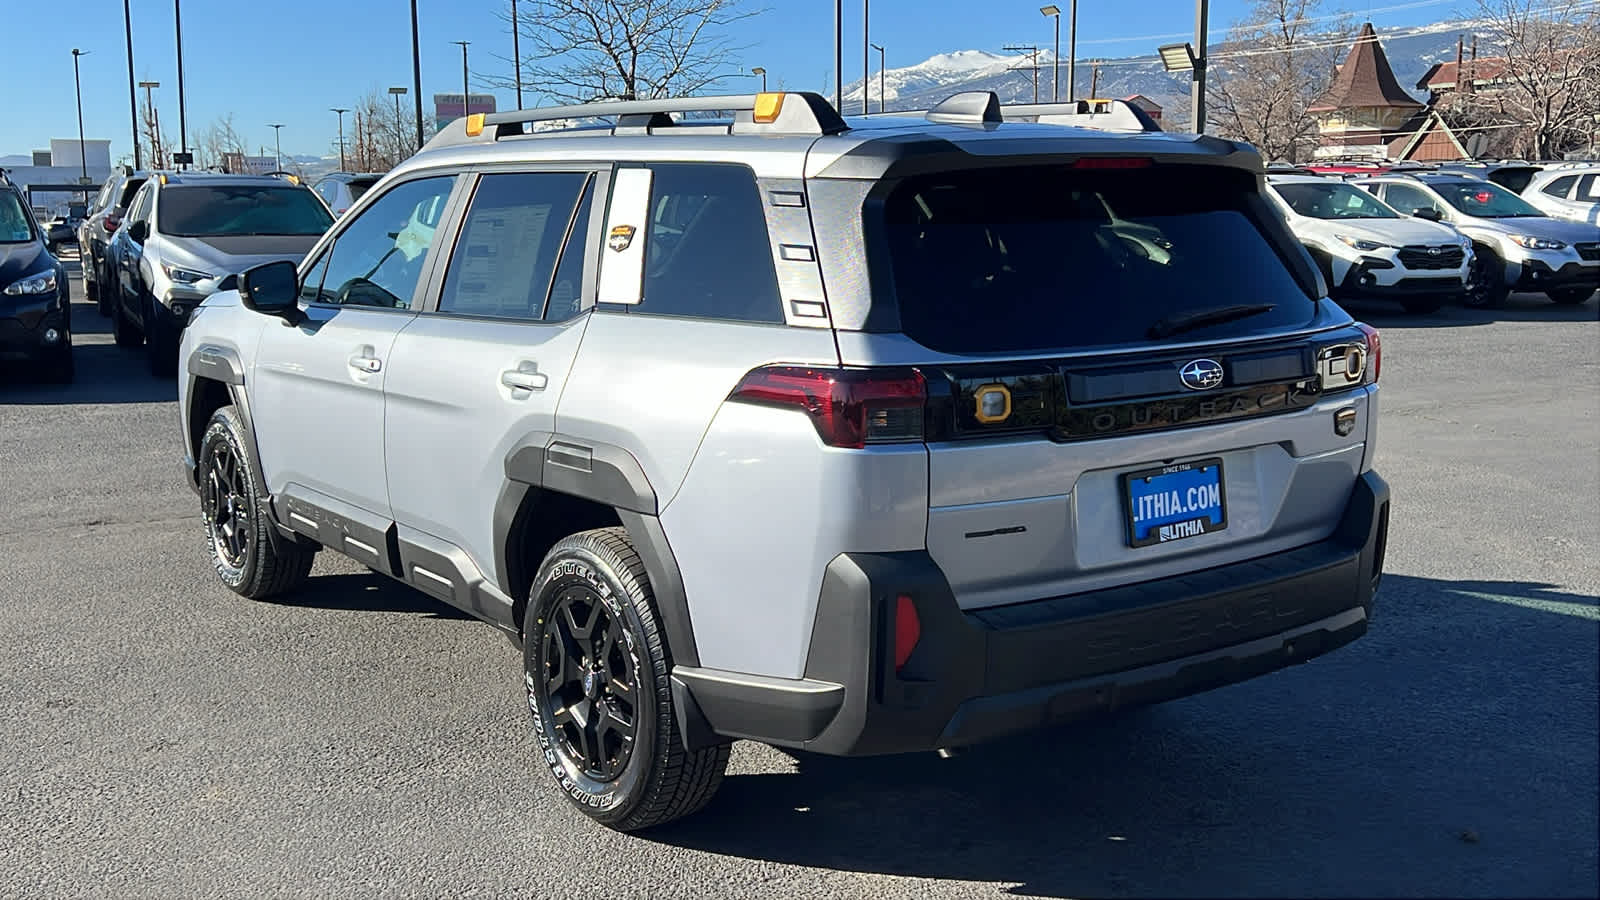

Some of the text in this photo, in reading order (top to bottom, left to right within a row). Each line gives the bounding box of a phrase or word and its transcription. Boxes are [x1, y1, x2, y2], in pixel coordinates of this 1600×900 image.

[1092, 389, 1300, 430] OUTBACK
[1162, 465, 1178, 474] SINCE
[1169, 519, 1204, 540] LITHIA
